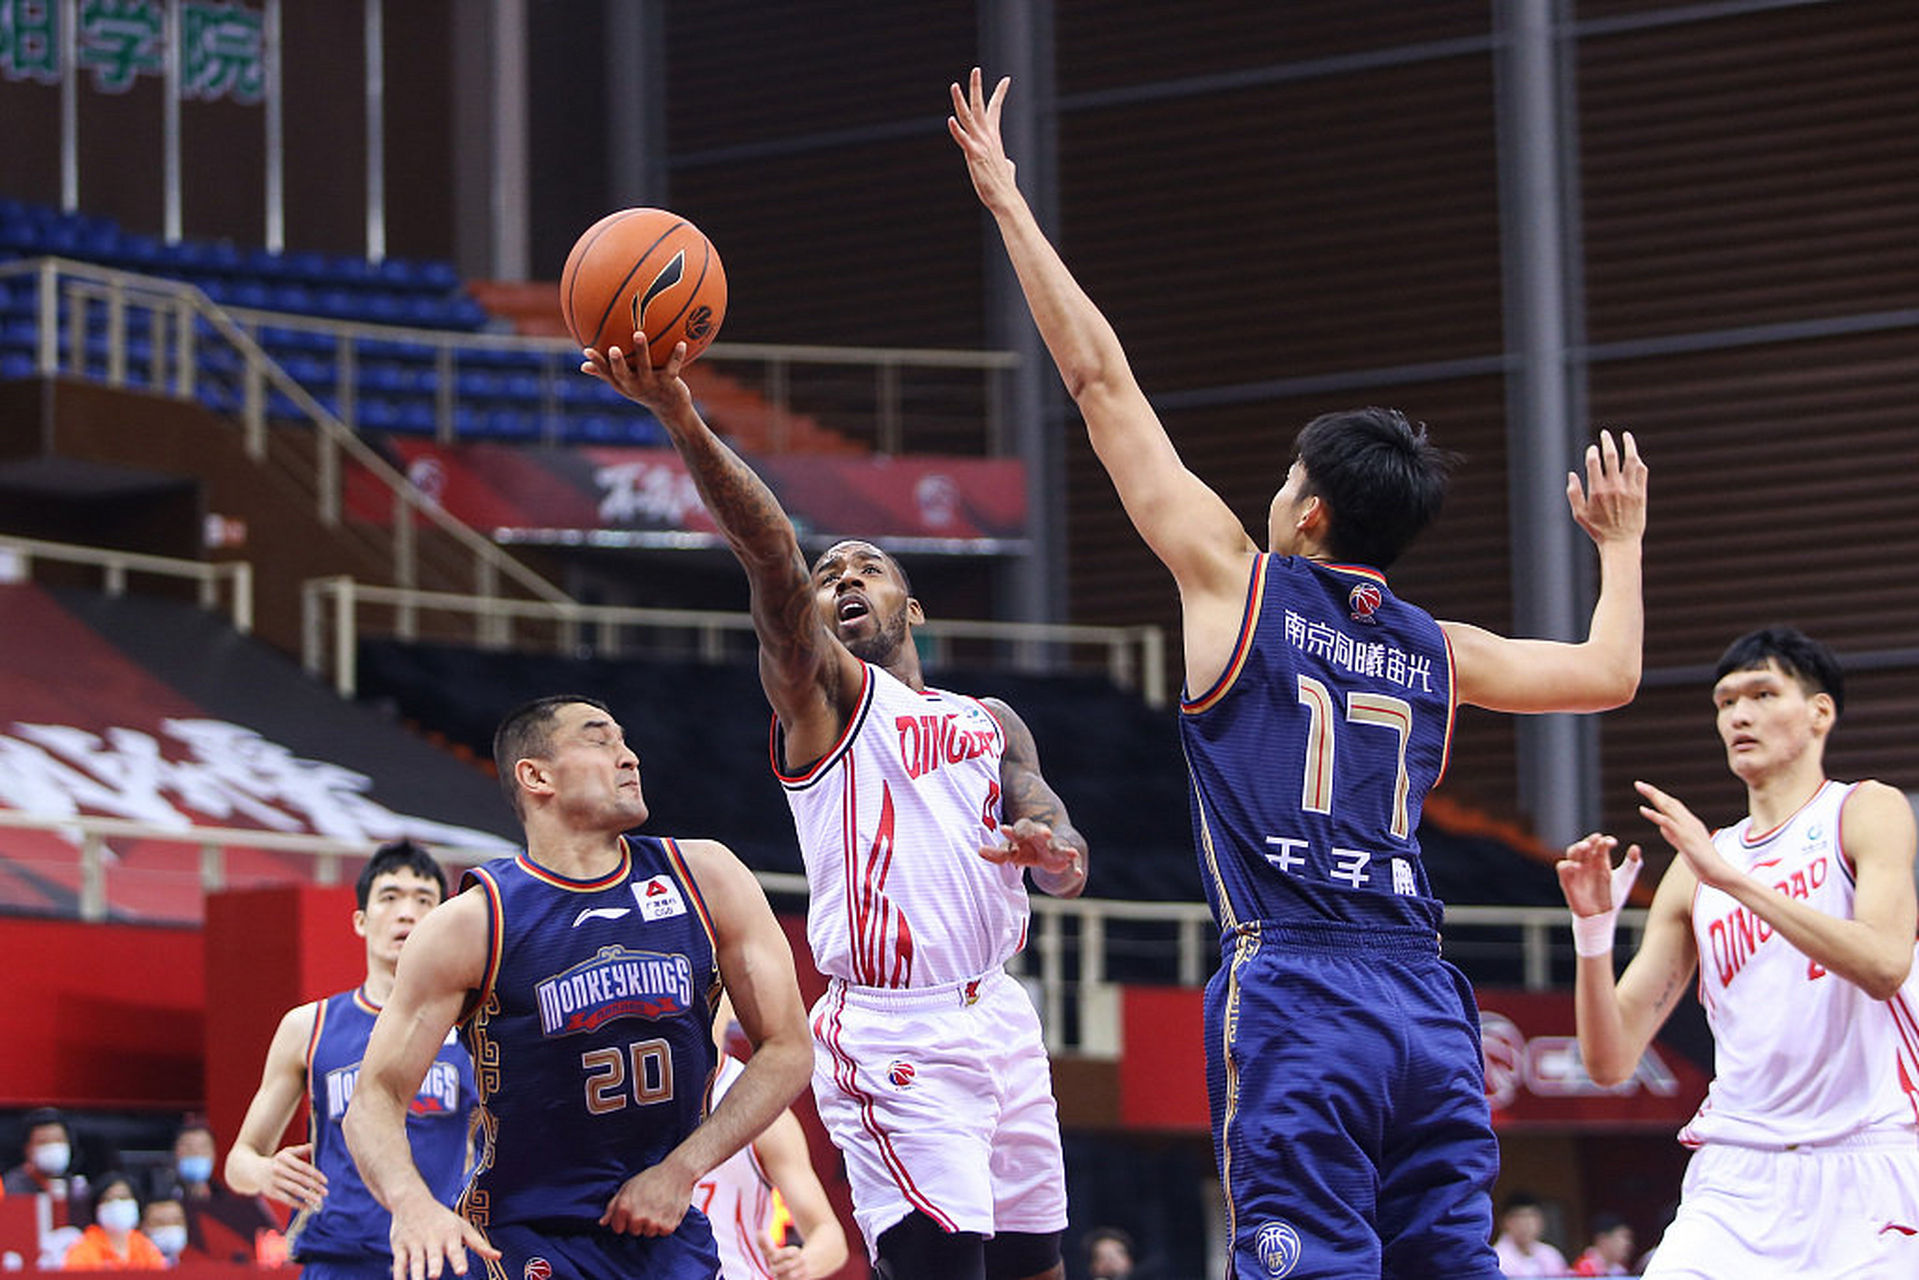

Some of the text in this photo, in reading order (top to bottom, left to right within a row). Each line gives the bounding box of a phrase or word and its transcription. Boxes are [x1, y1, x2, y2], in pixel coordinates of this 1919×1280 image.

[1285, 609, 1432, 692] 南京同曦宙光
[1297, 674, 1412, 840] 17
[539, 957, 691, 1033] MONKEYKINGS
[581, 1037, 674, 1115] 20
